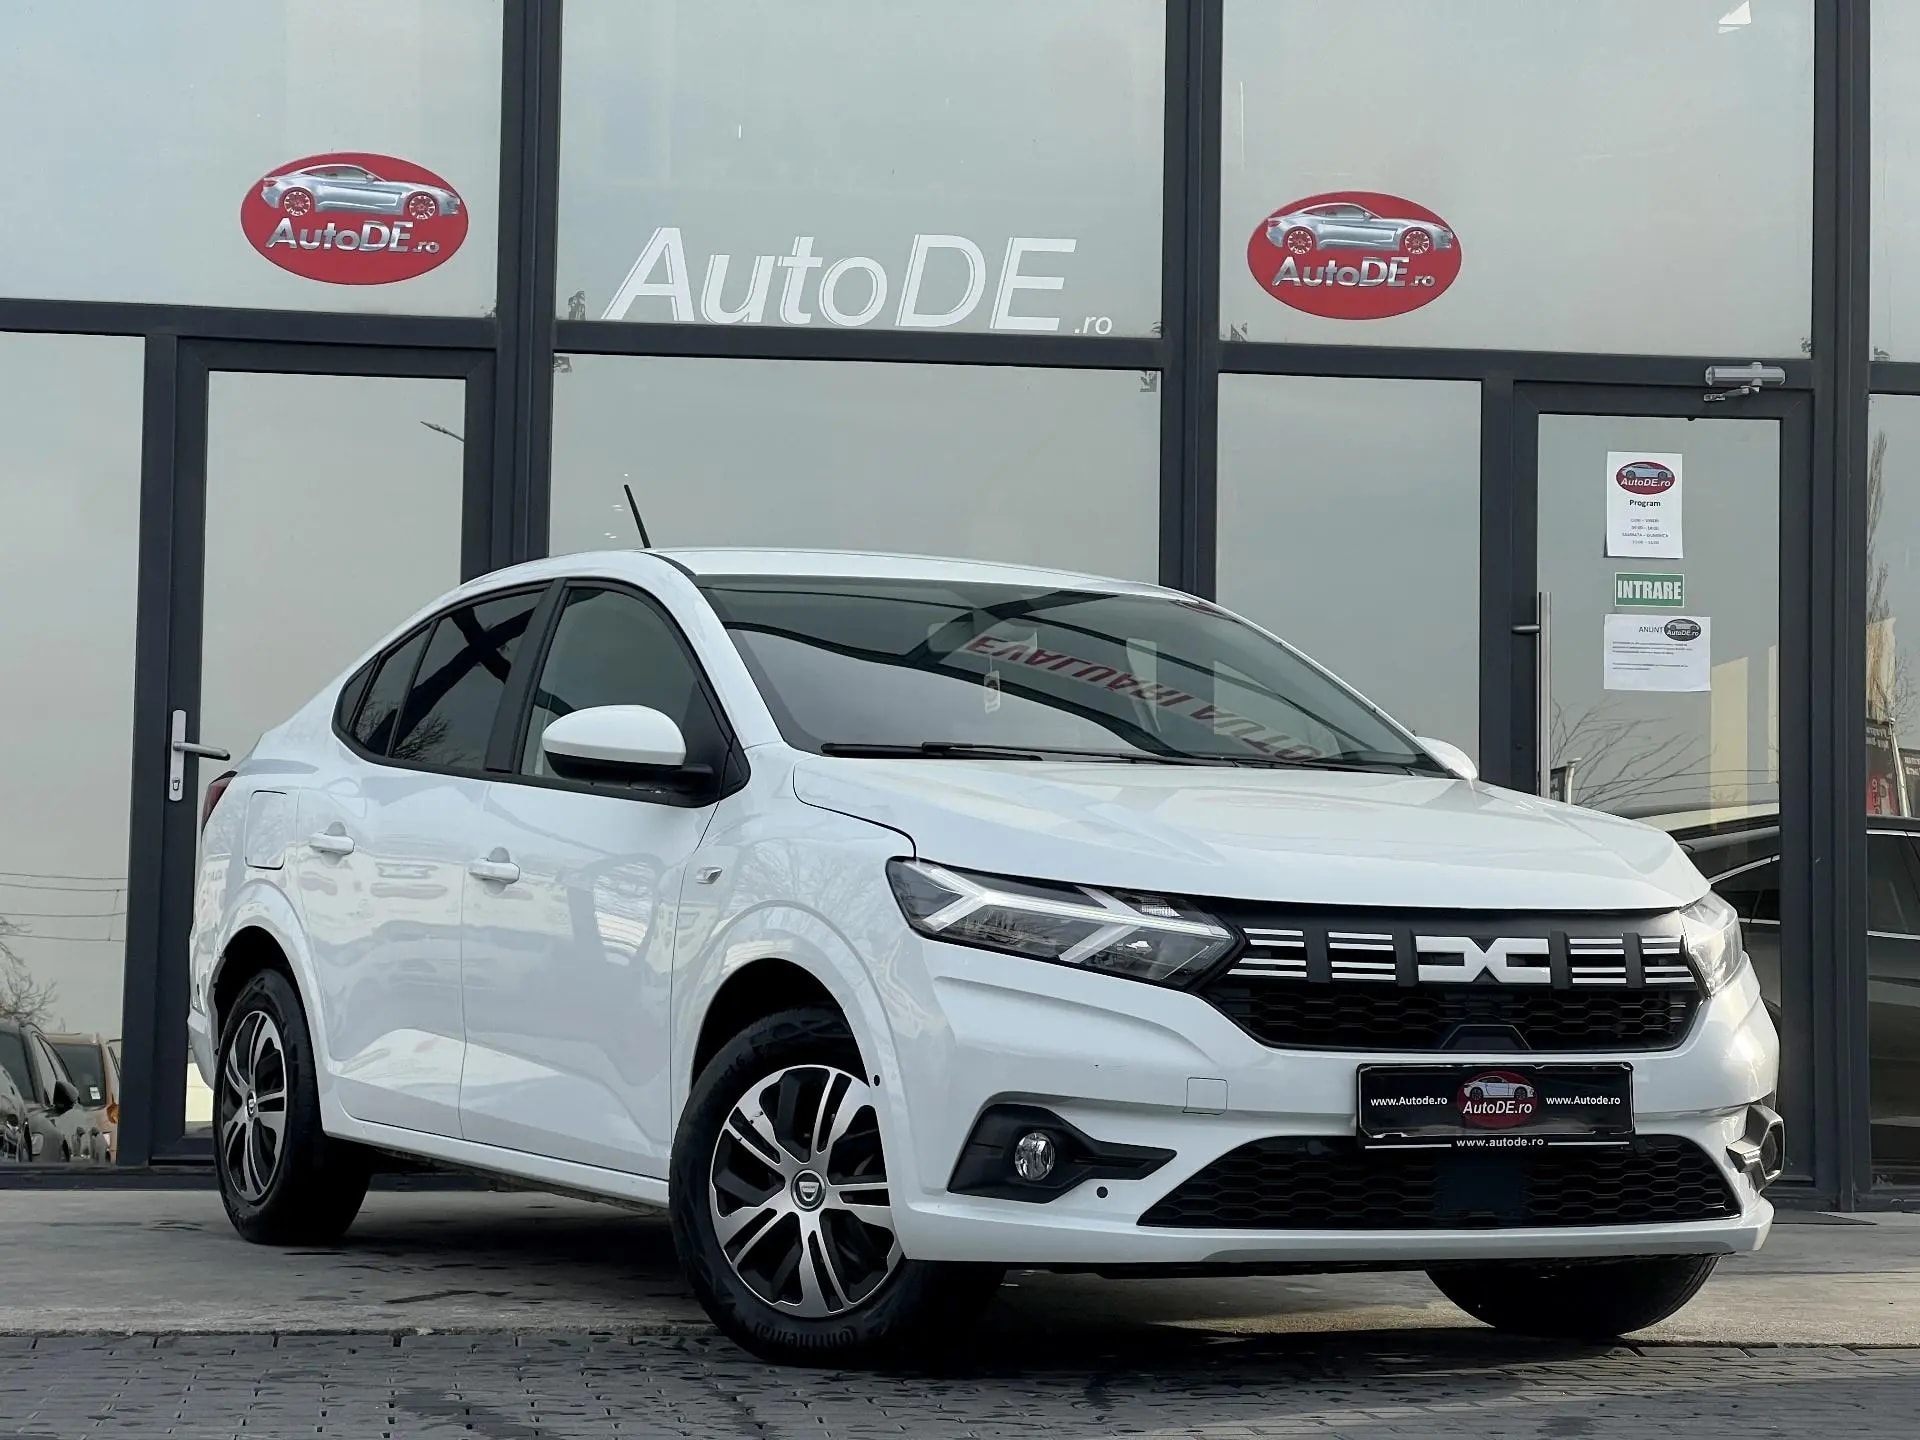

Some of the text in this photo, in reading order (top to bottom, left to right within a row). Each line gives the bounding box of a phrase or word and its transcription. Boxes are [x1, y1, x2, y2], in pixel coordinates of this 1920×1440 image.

[265, 217, 440, 254] AutoDE.ro
[1271, 256, 1437, 287] AutoDE.ro
[600, 227, 1113, 336] AutoDE.ro
[1620, 477, 1671, 488] AutoDE.ro
[1629, 498, 1661, 508] Program
[1617, 580, 1682, 600] INTRARE
[1370, 1095, 1448, 1106] www.Autode.ro
[1546, 1095, 1621, 1105] www.Autode.ro
[1463, 1100, 1533, 1114] AutoDE.ro
[1456, 1136, 1544, 1148] www.autode.ro
